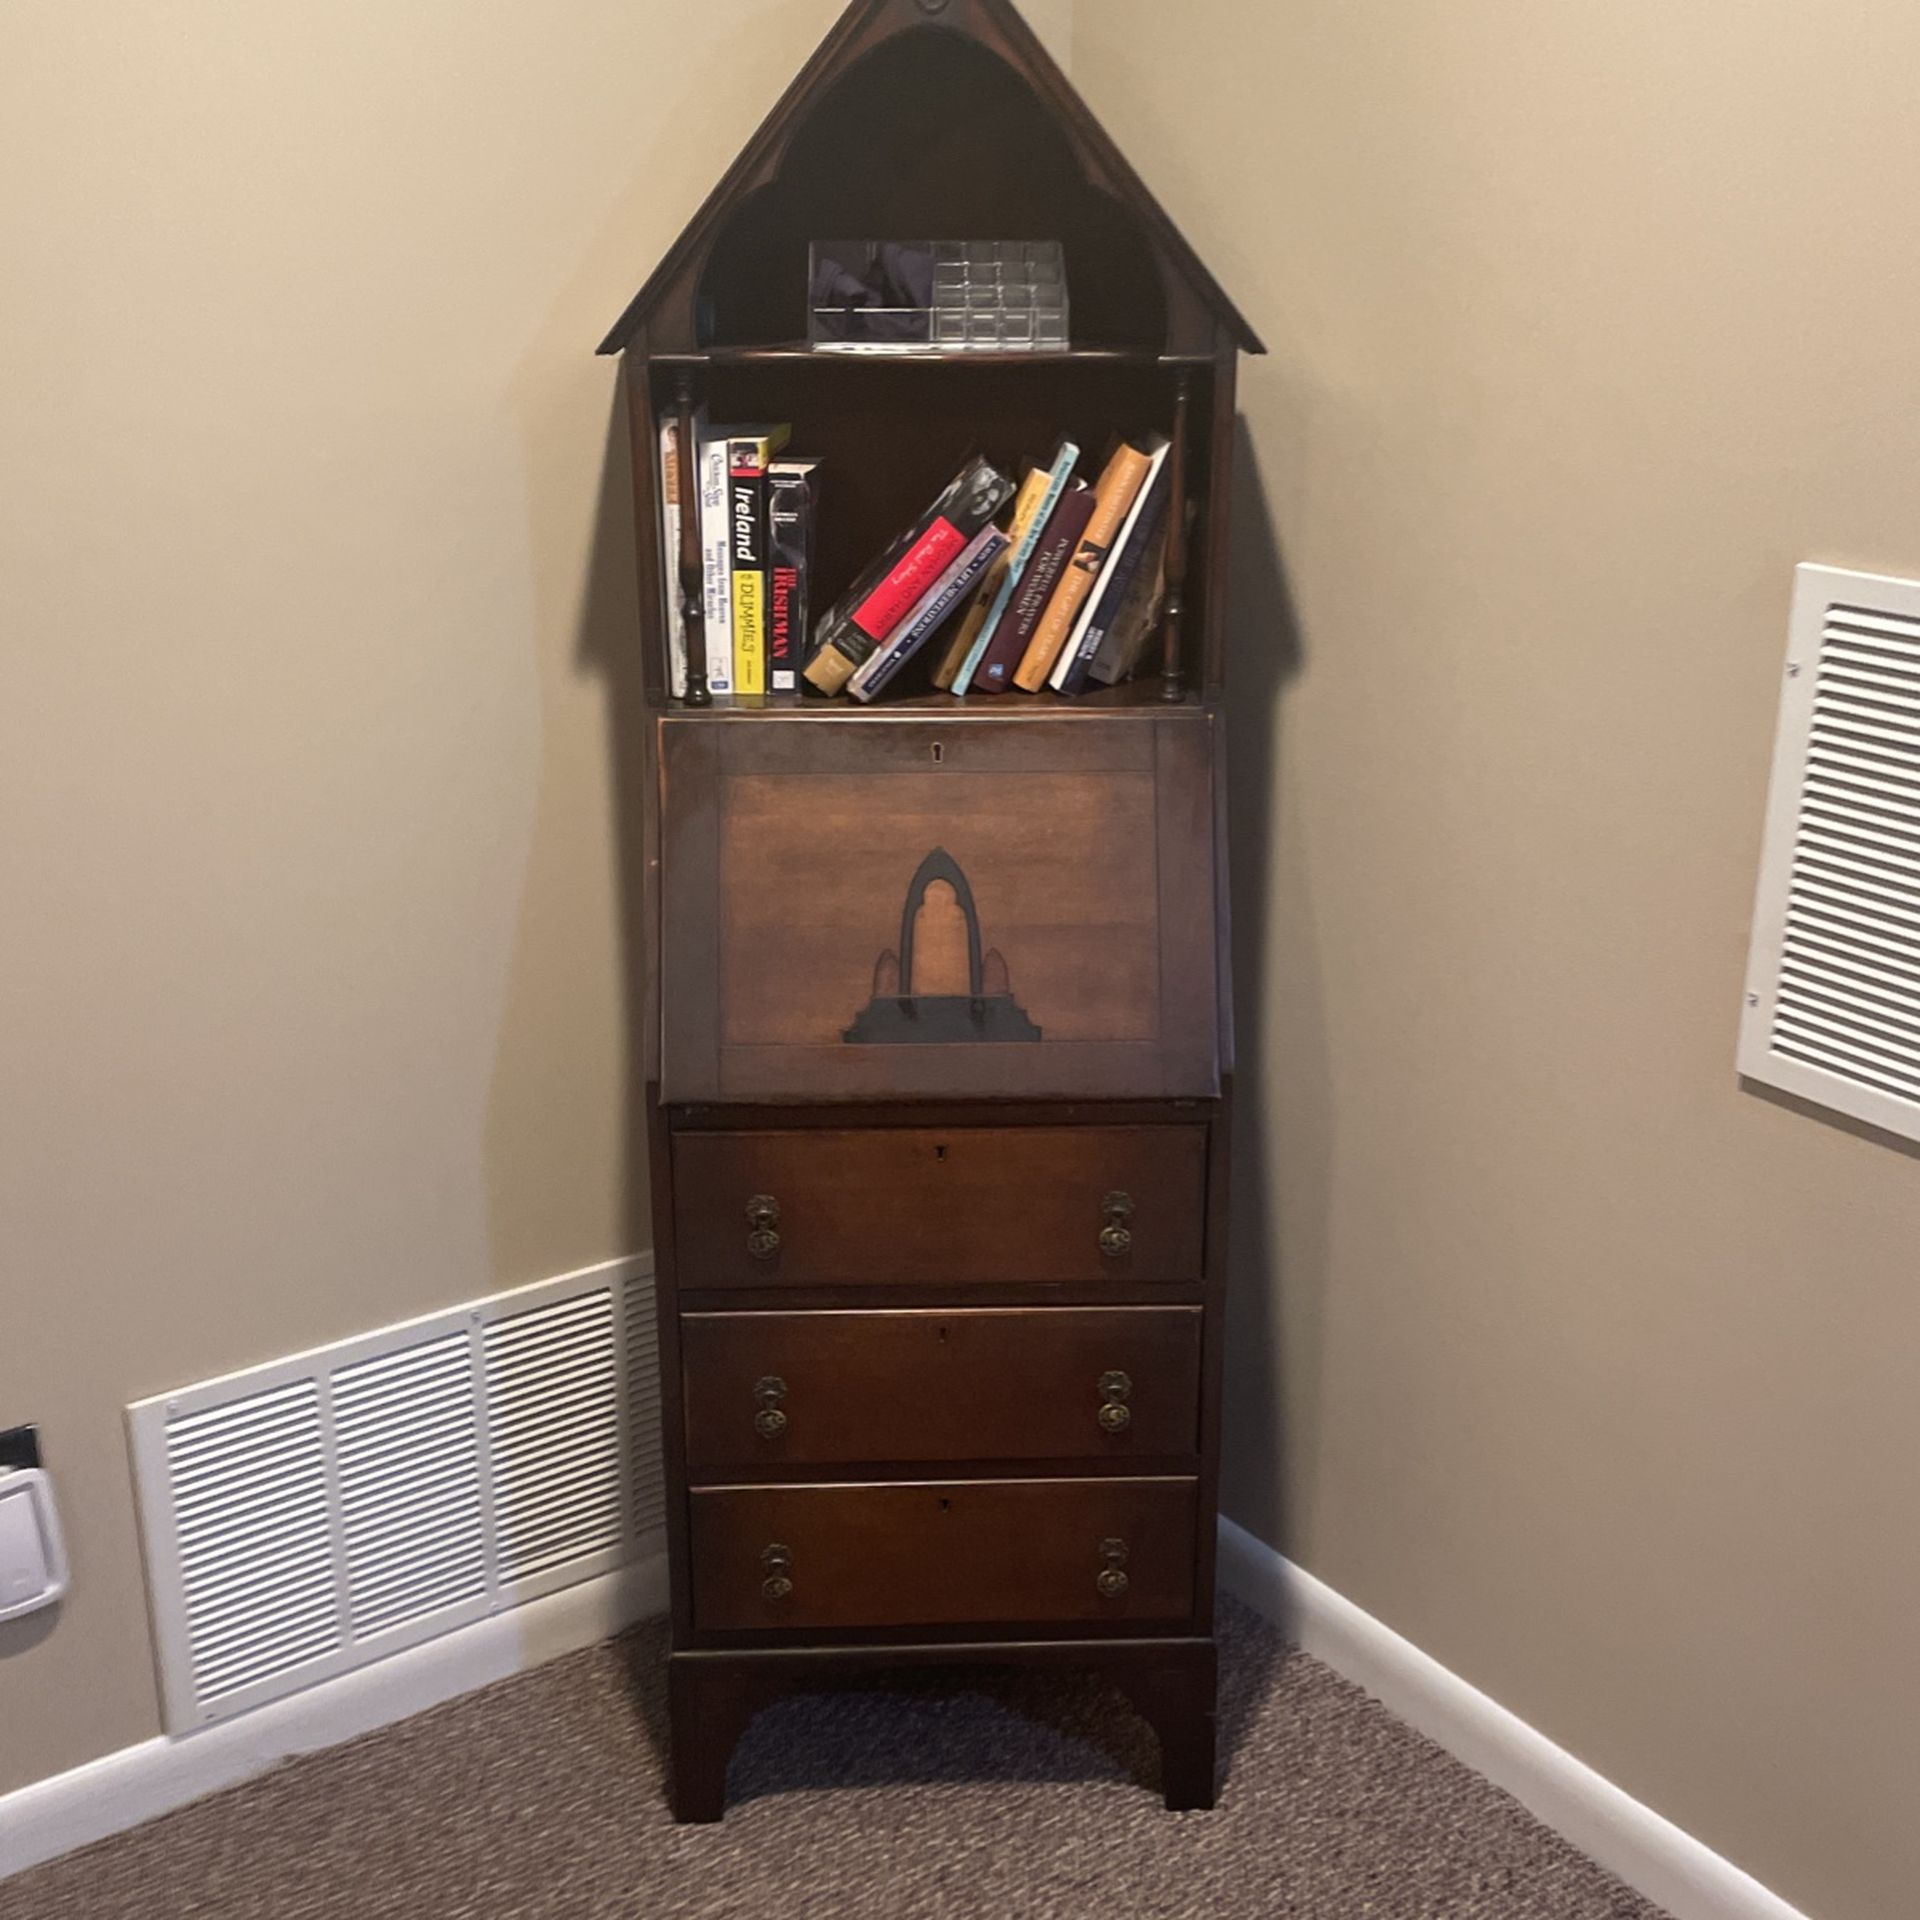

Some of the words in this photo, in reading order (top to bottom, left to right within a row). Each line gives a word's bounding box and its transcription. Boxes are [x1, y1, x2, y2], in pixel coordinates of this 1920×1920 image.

[734, 487, 757, 563] Ireland
[929, 526, 948, 545] The
[913, 543, 934, 564] Real
[918, 534, 959, 579] MEGHAN
[1035, 550, 1051, 574] FOR
[1037, 537, 1069, 592] POWERFUL
[890, 560, 918, 587] Story
[900, 576, 923, 599] AND
[954, 566, 974, 588] LIFE
[772, 567, 789, 657] IRISHMAN
[1015, 572, 1041, 615] WOMEN
[740, 583, 754, 653] DUMMIES
[874, 599, 904, 633] HARRY
[1016, 593, 1042, 636] PRAYERS
